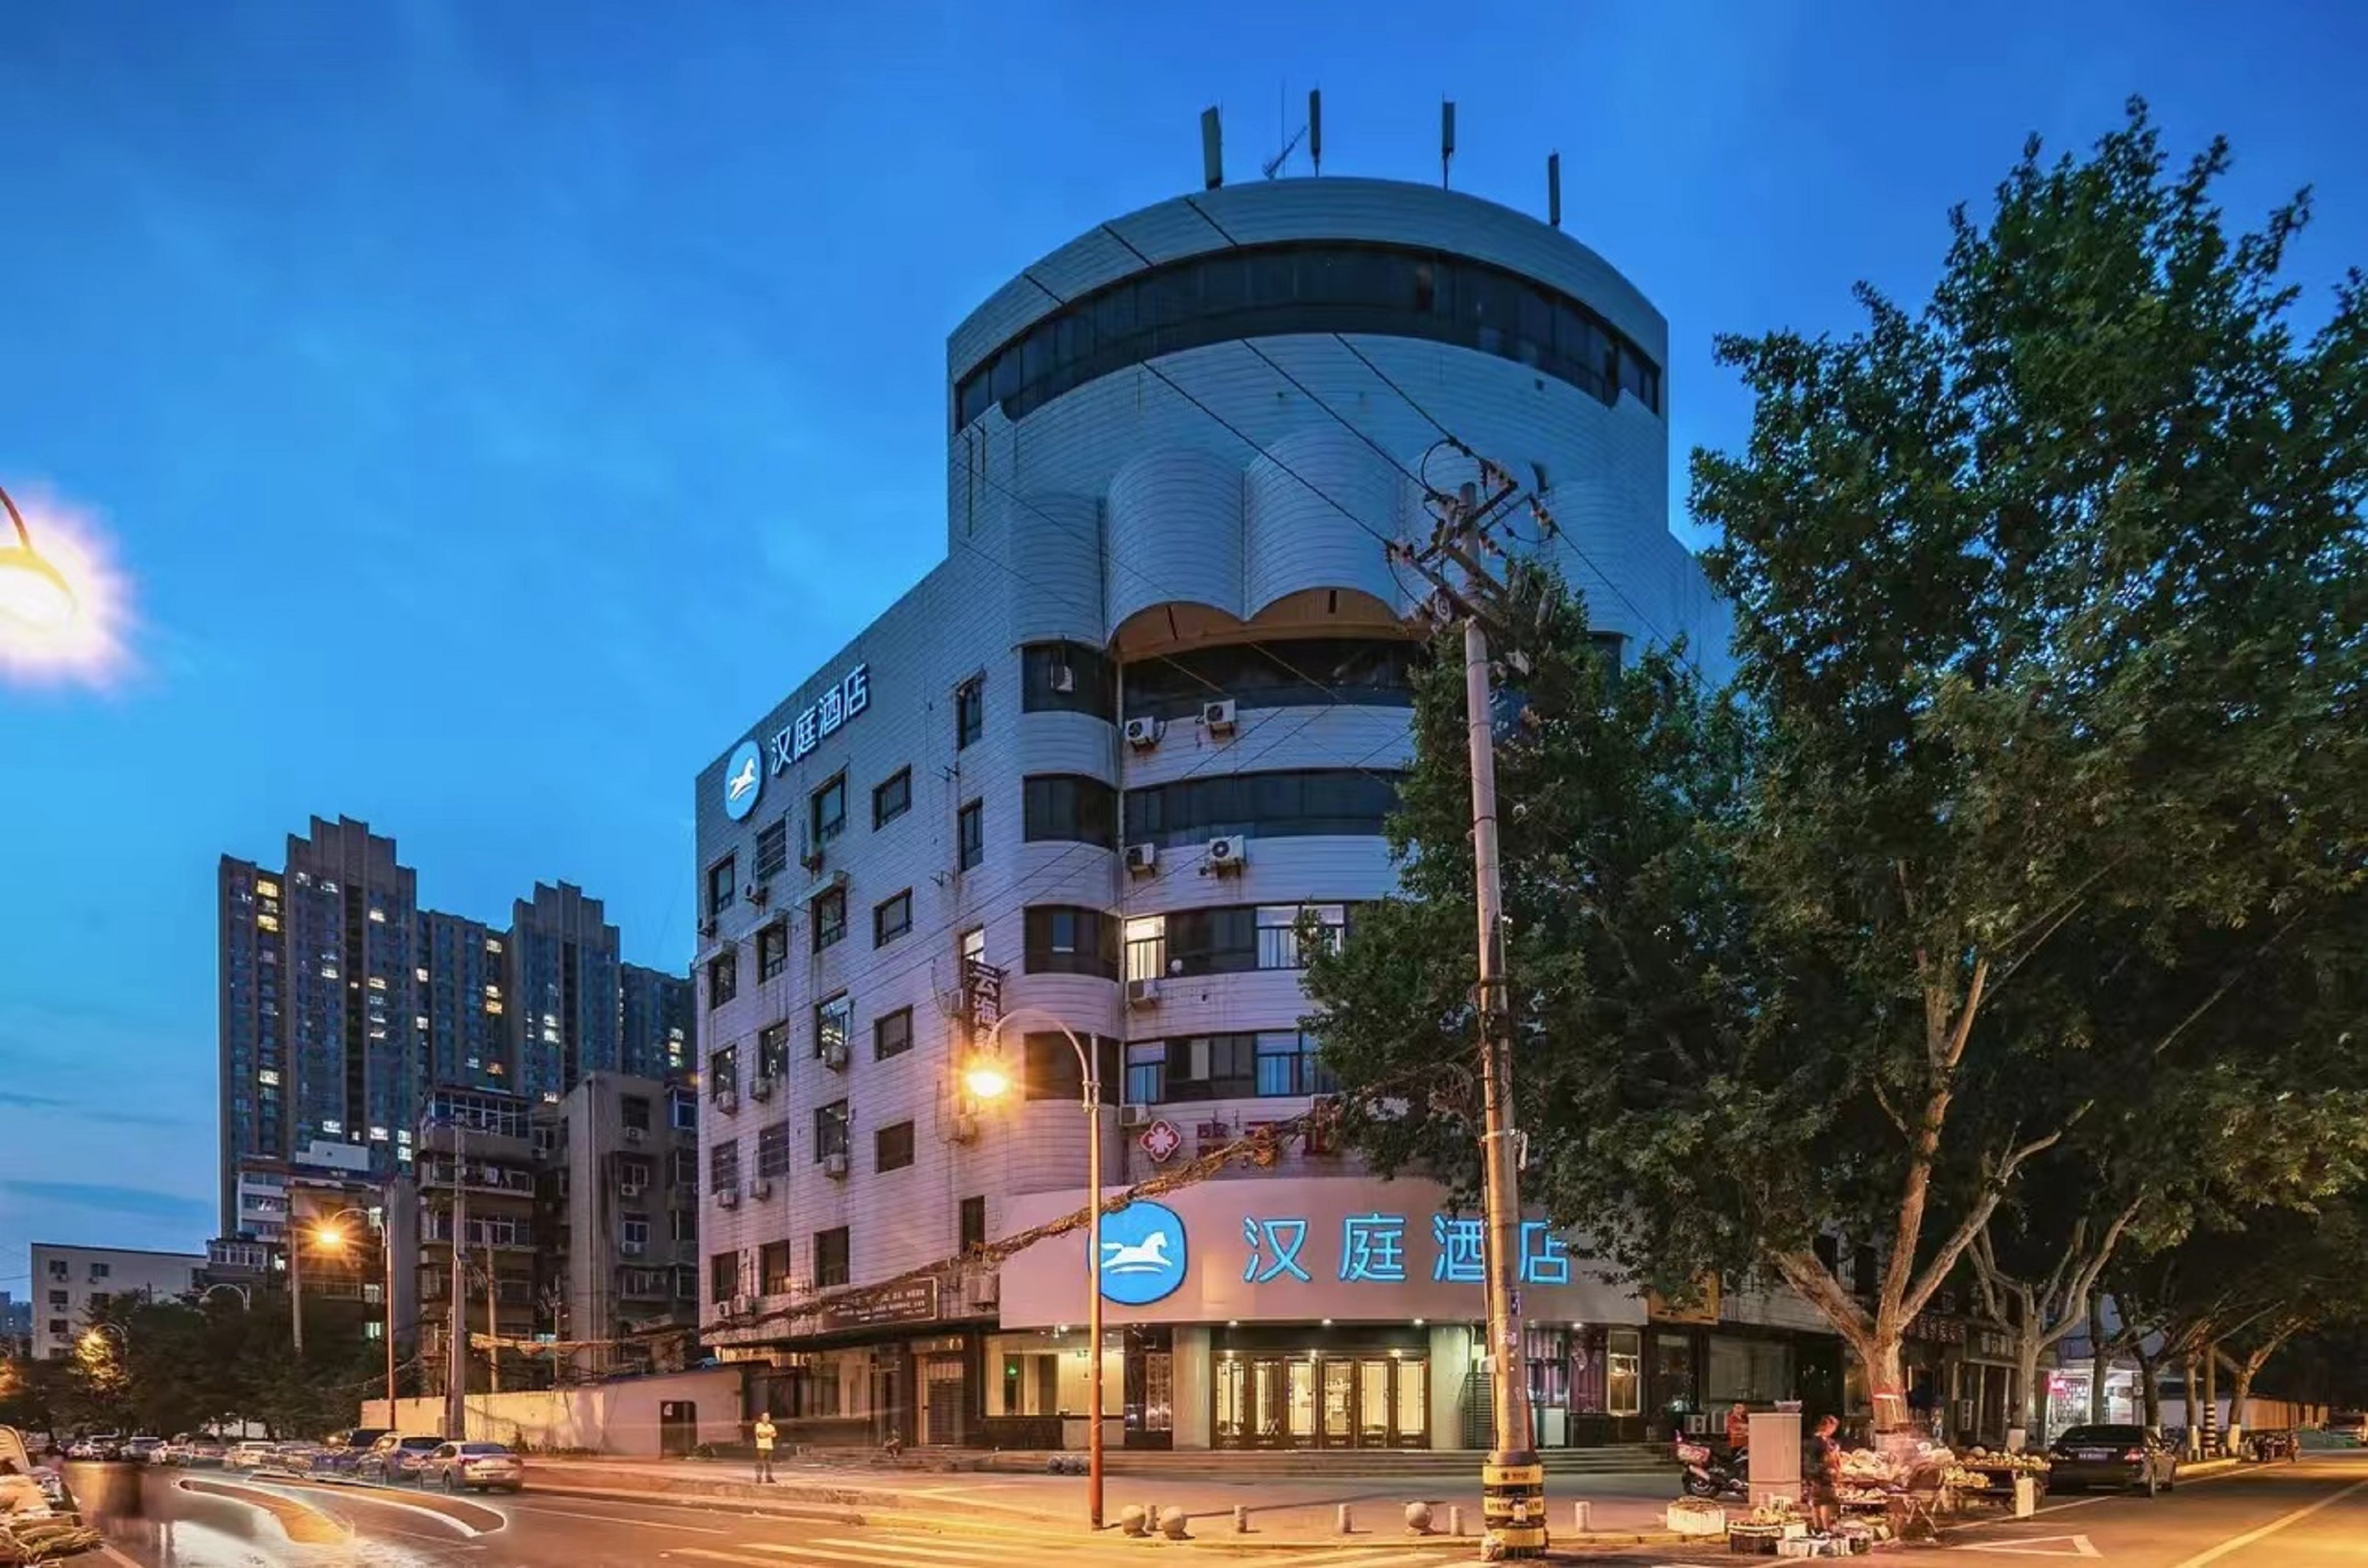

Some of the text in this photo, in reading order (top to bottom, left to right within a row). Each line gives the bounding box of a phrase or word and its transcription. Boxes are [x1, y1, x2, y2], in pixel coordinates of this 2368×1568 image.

[770, 663, 867, 776] 汉庭酒店
[1242, 1213, 1569, 1284] 汉庭酒店
